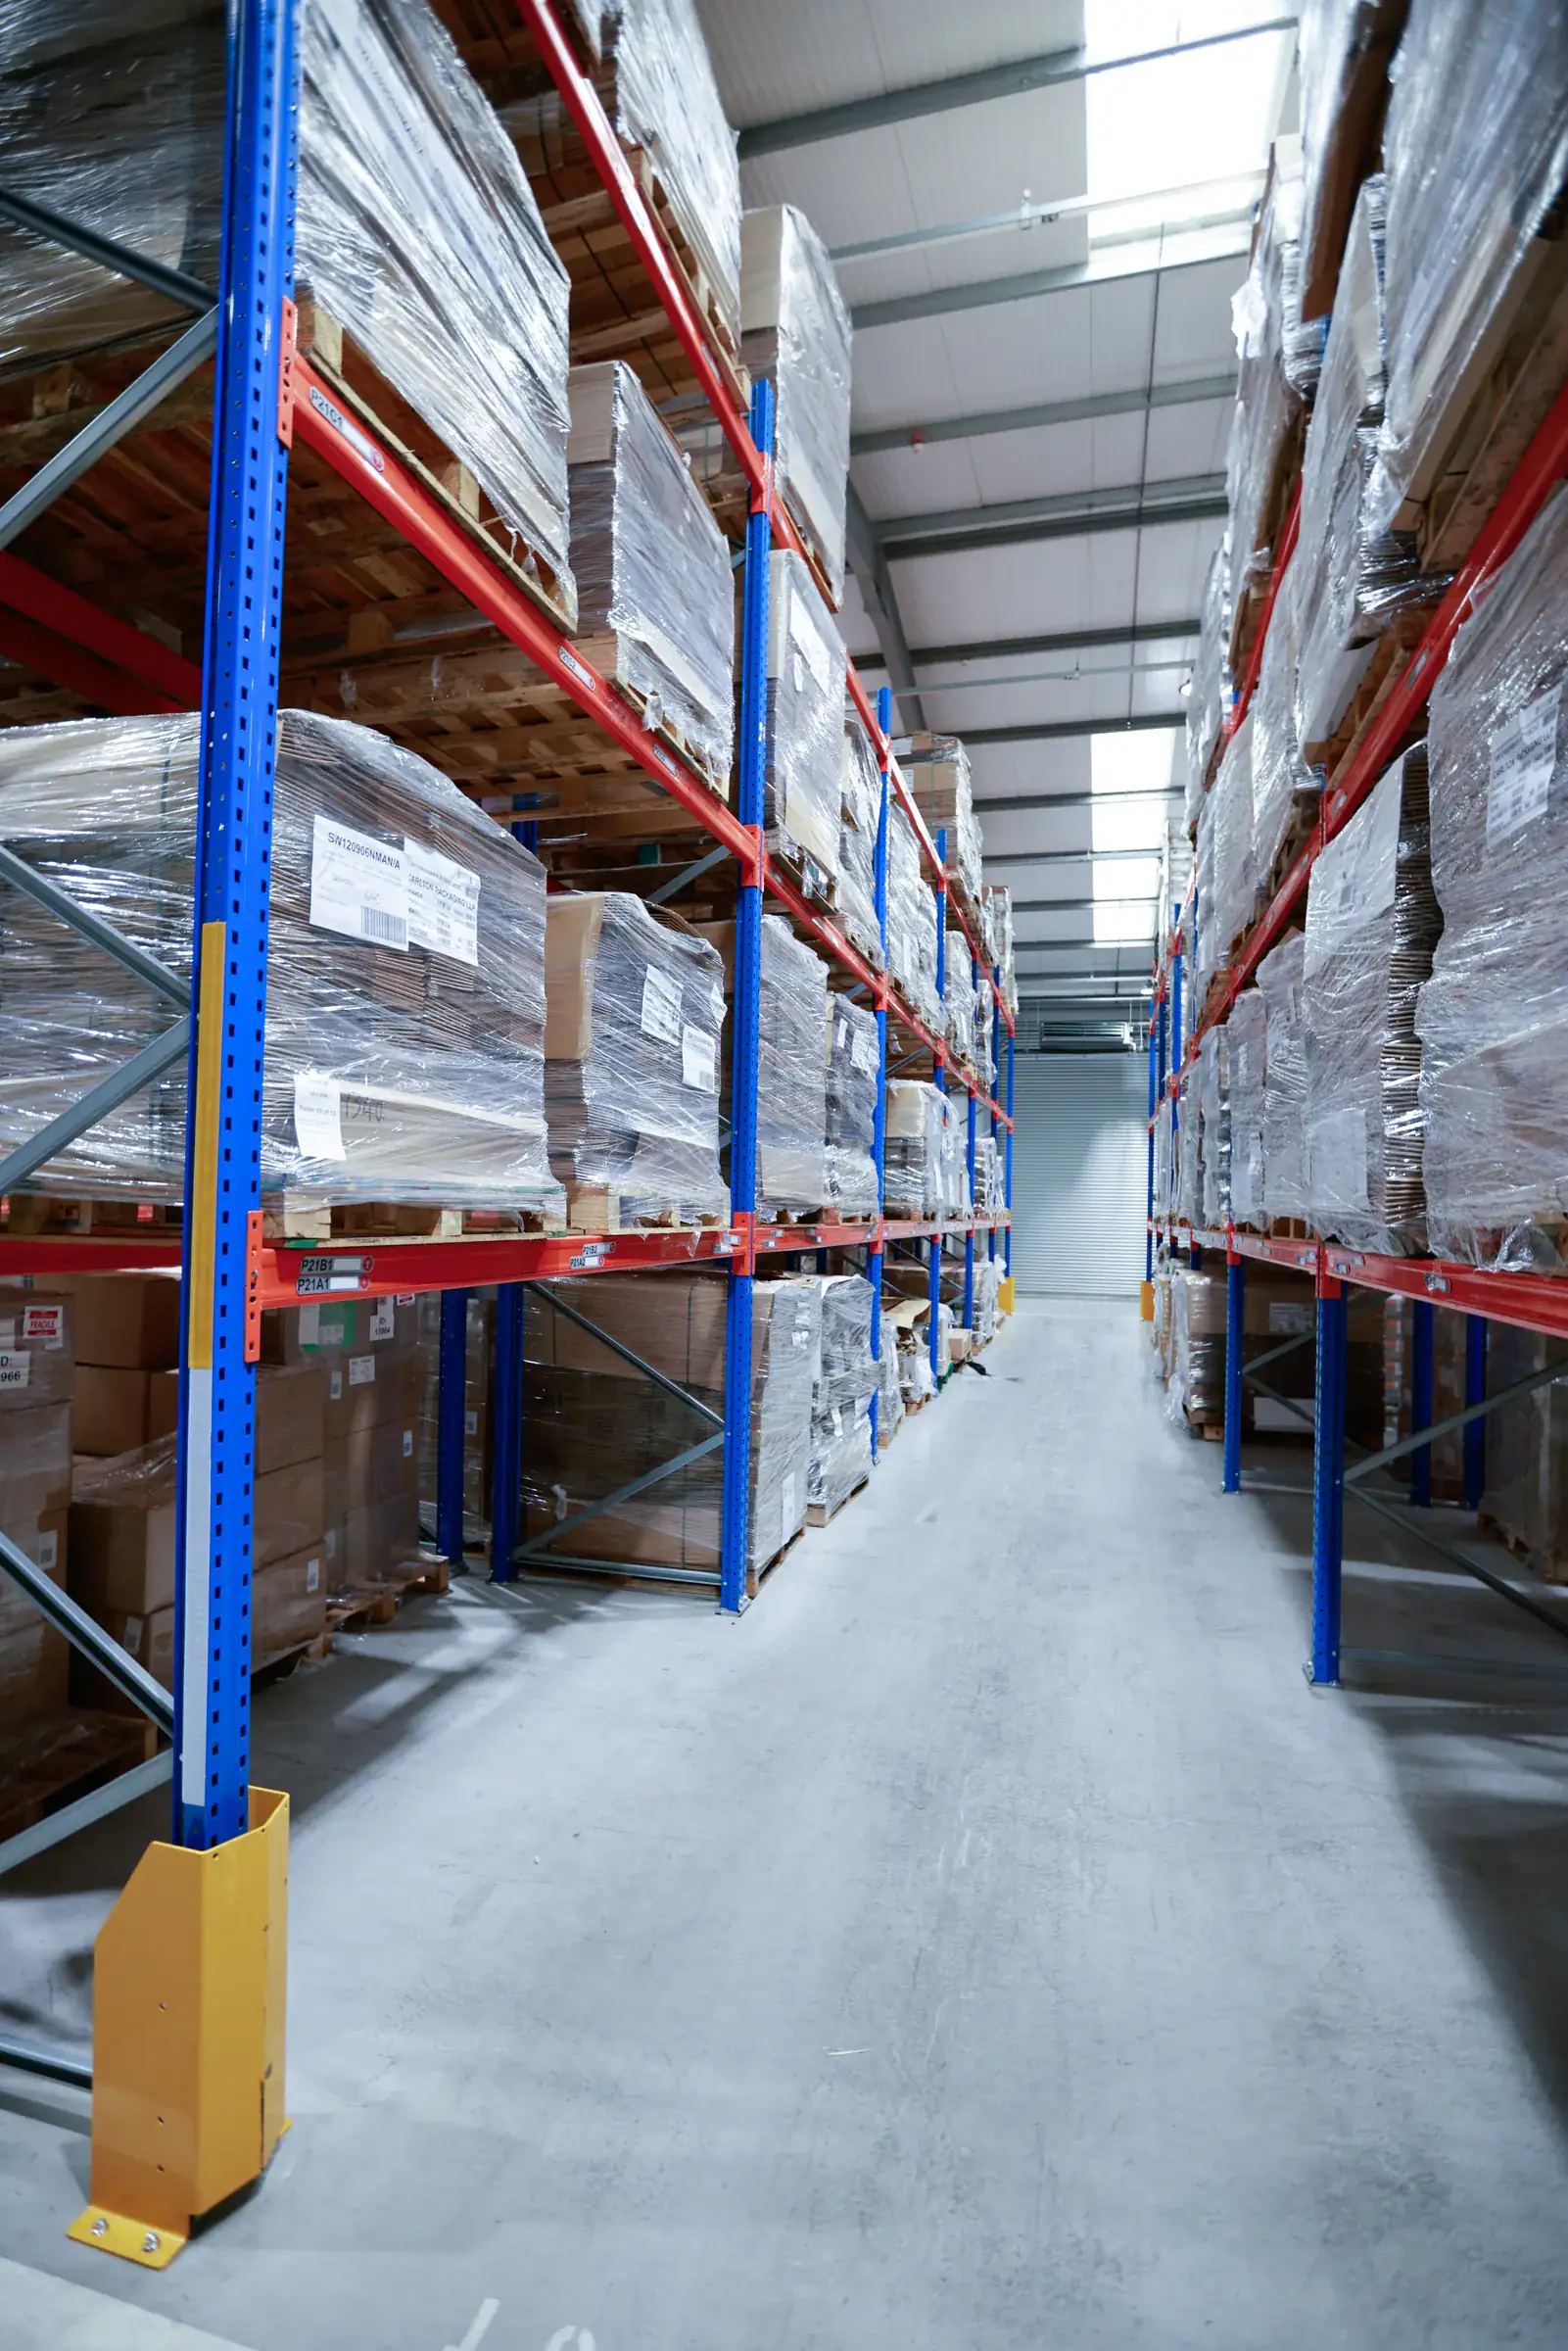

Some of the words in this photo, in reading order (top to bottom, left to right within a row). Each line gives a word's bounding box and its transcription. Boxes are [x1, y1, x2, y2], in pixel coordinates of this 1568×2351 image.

[311, 389, 343, 429] P21C1
[583, 1245, 597, 1255] P21B2
[301, 1259, 333, 1271] P21B1
[570, 1258, 586, 1268] P21A2
[297, 1277, 329, 1291] P21A1
[31, 1319, 55, 1329] FRAGILE
